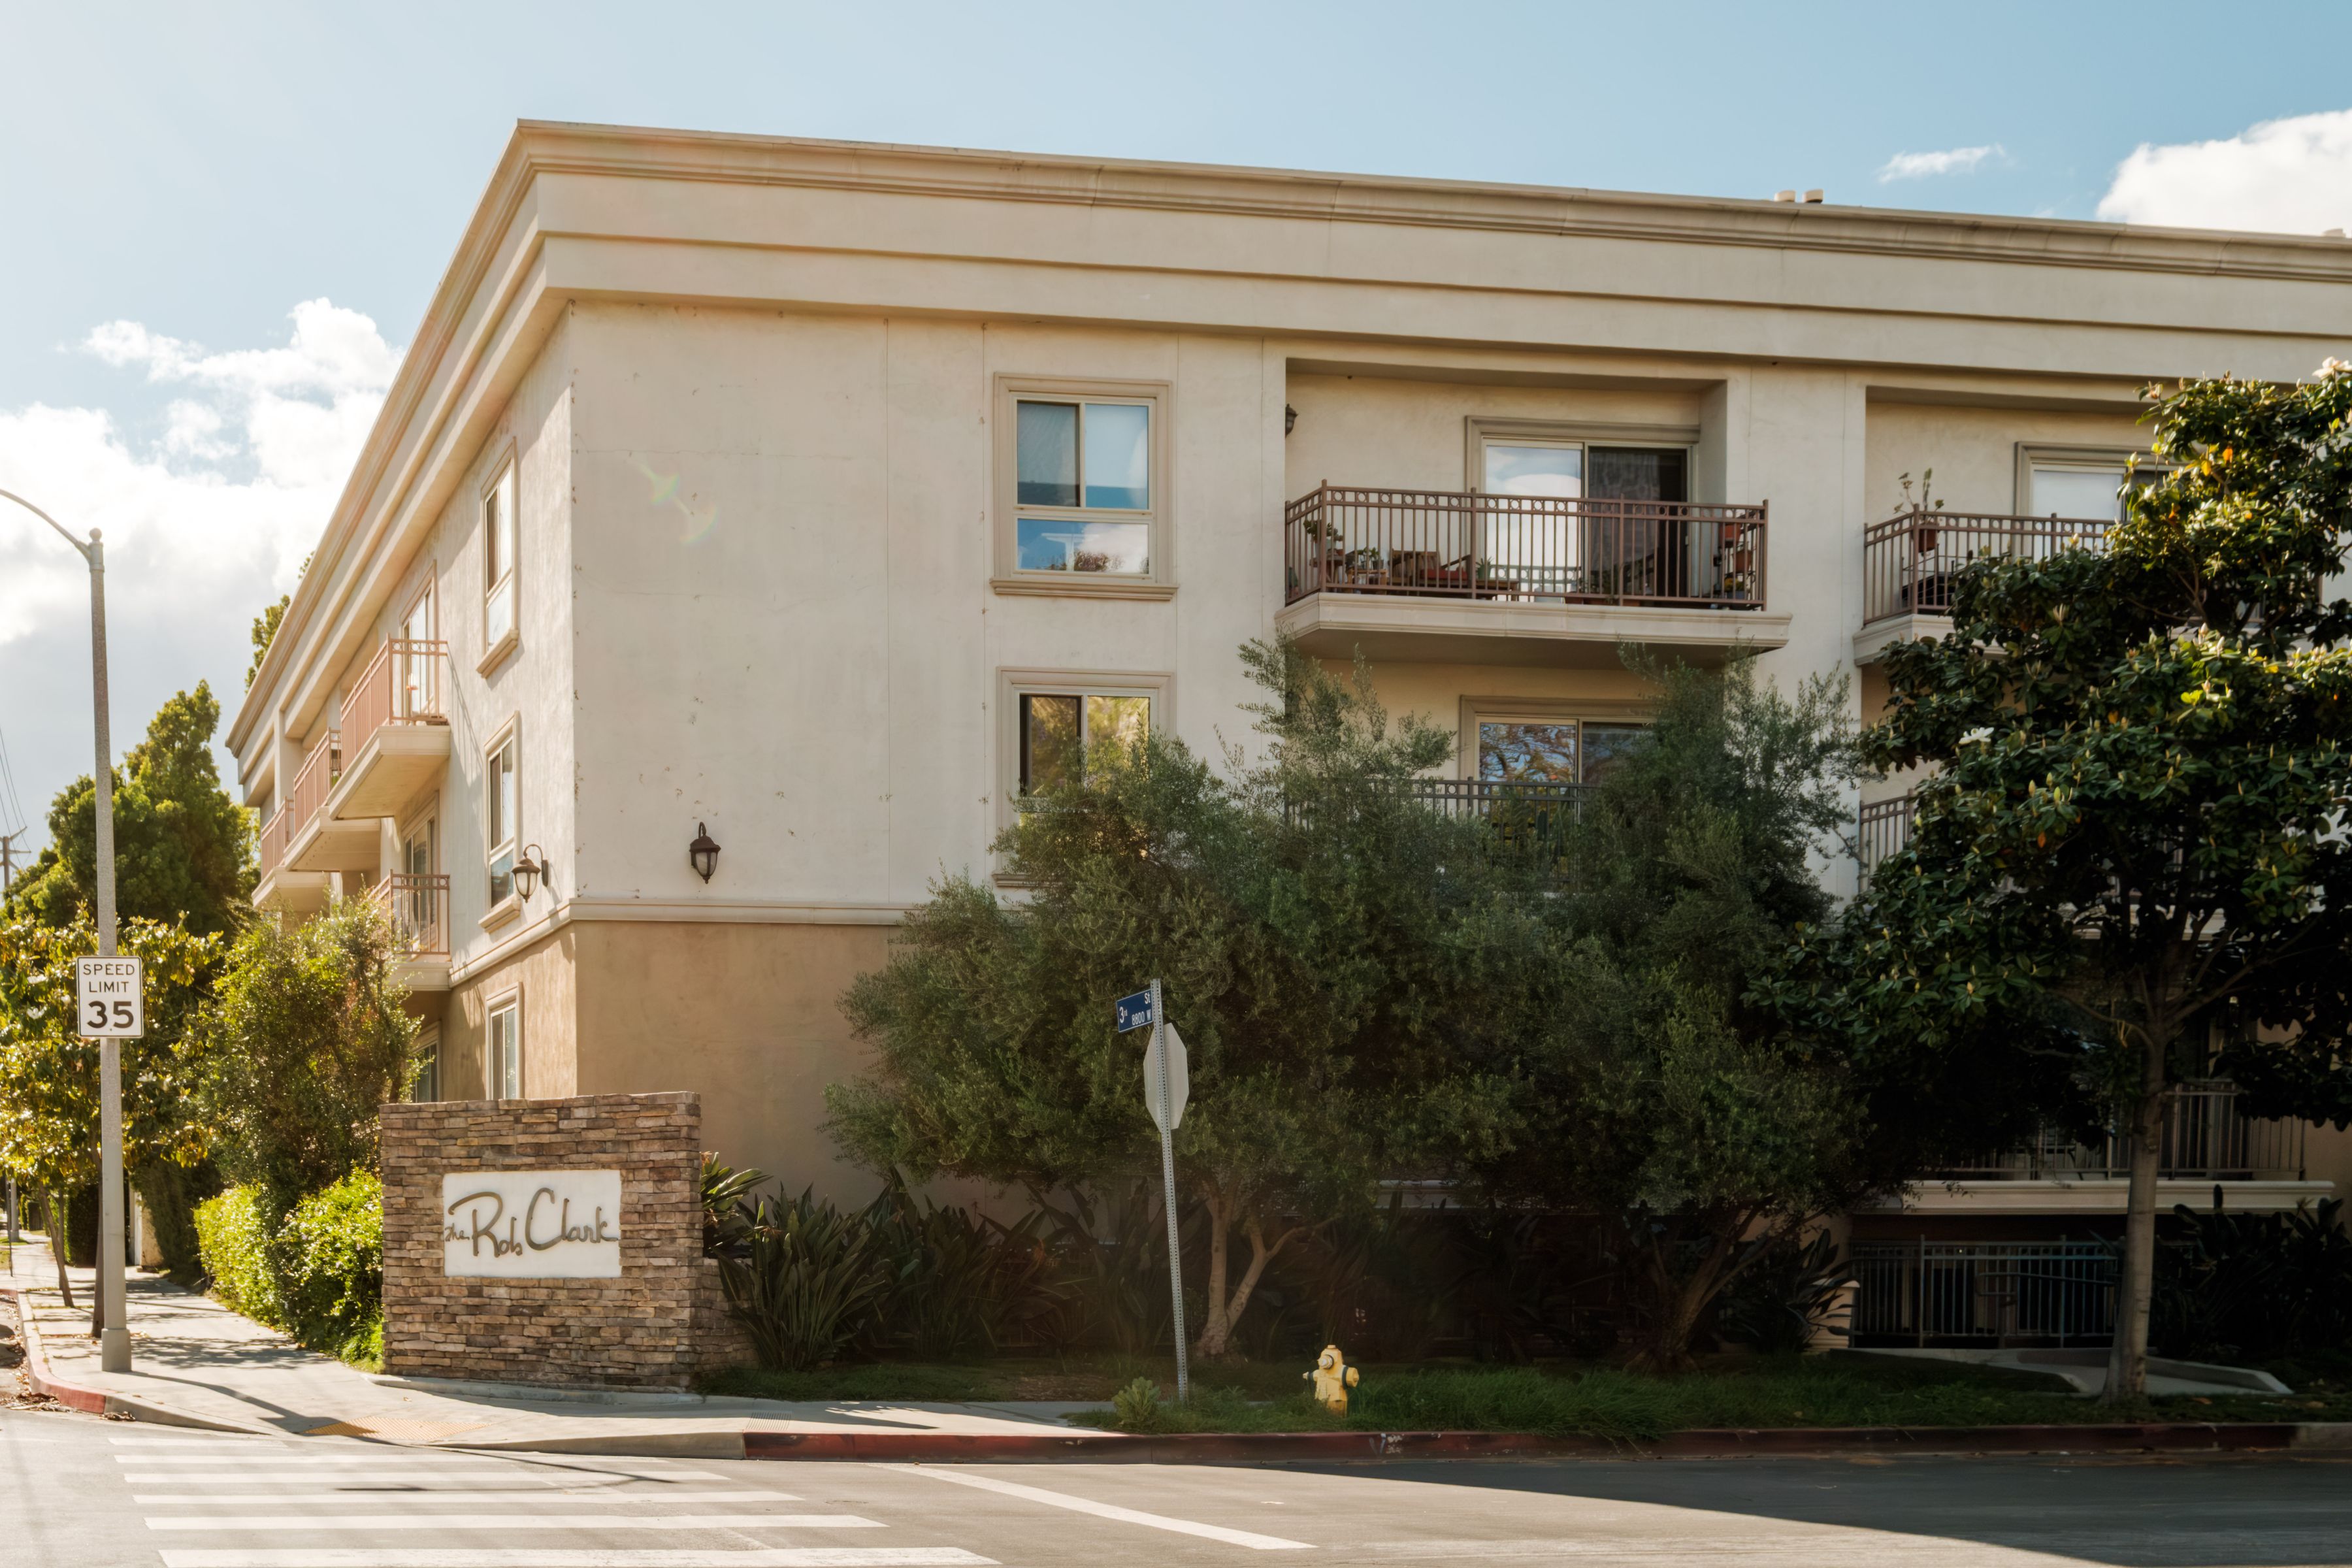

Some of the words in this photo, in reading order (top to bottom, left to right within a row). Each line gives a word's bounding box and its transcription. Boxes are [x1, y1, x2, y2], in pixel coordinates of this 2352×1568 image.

[83, 964, 135, 975] SPEED
[89, 981, 129, 992] LIMIT
[1145, 992, 1151, 1004] St
[87, 1000, 134, 1028] 35
[1132, 1011, 1145, 1025] 8800
[1147, 1009, 1151, 1021] W
[448, 1191, 523, 1258] Rob
[525, 1187, 619, 1250] Clark
